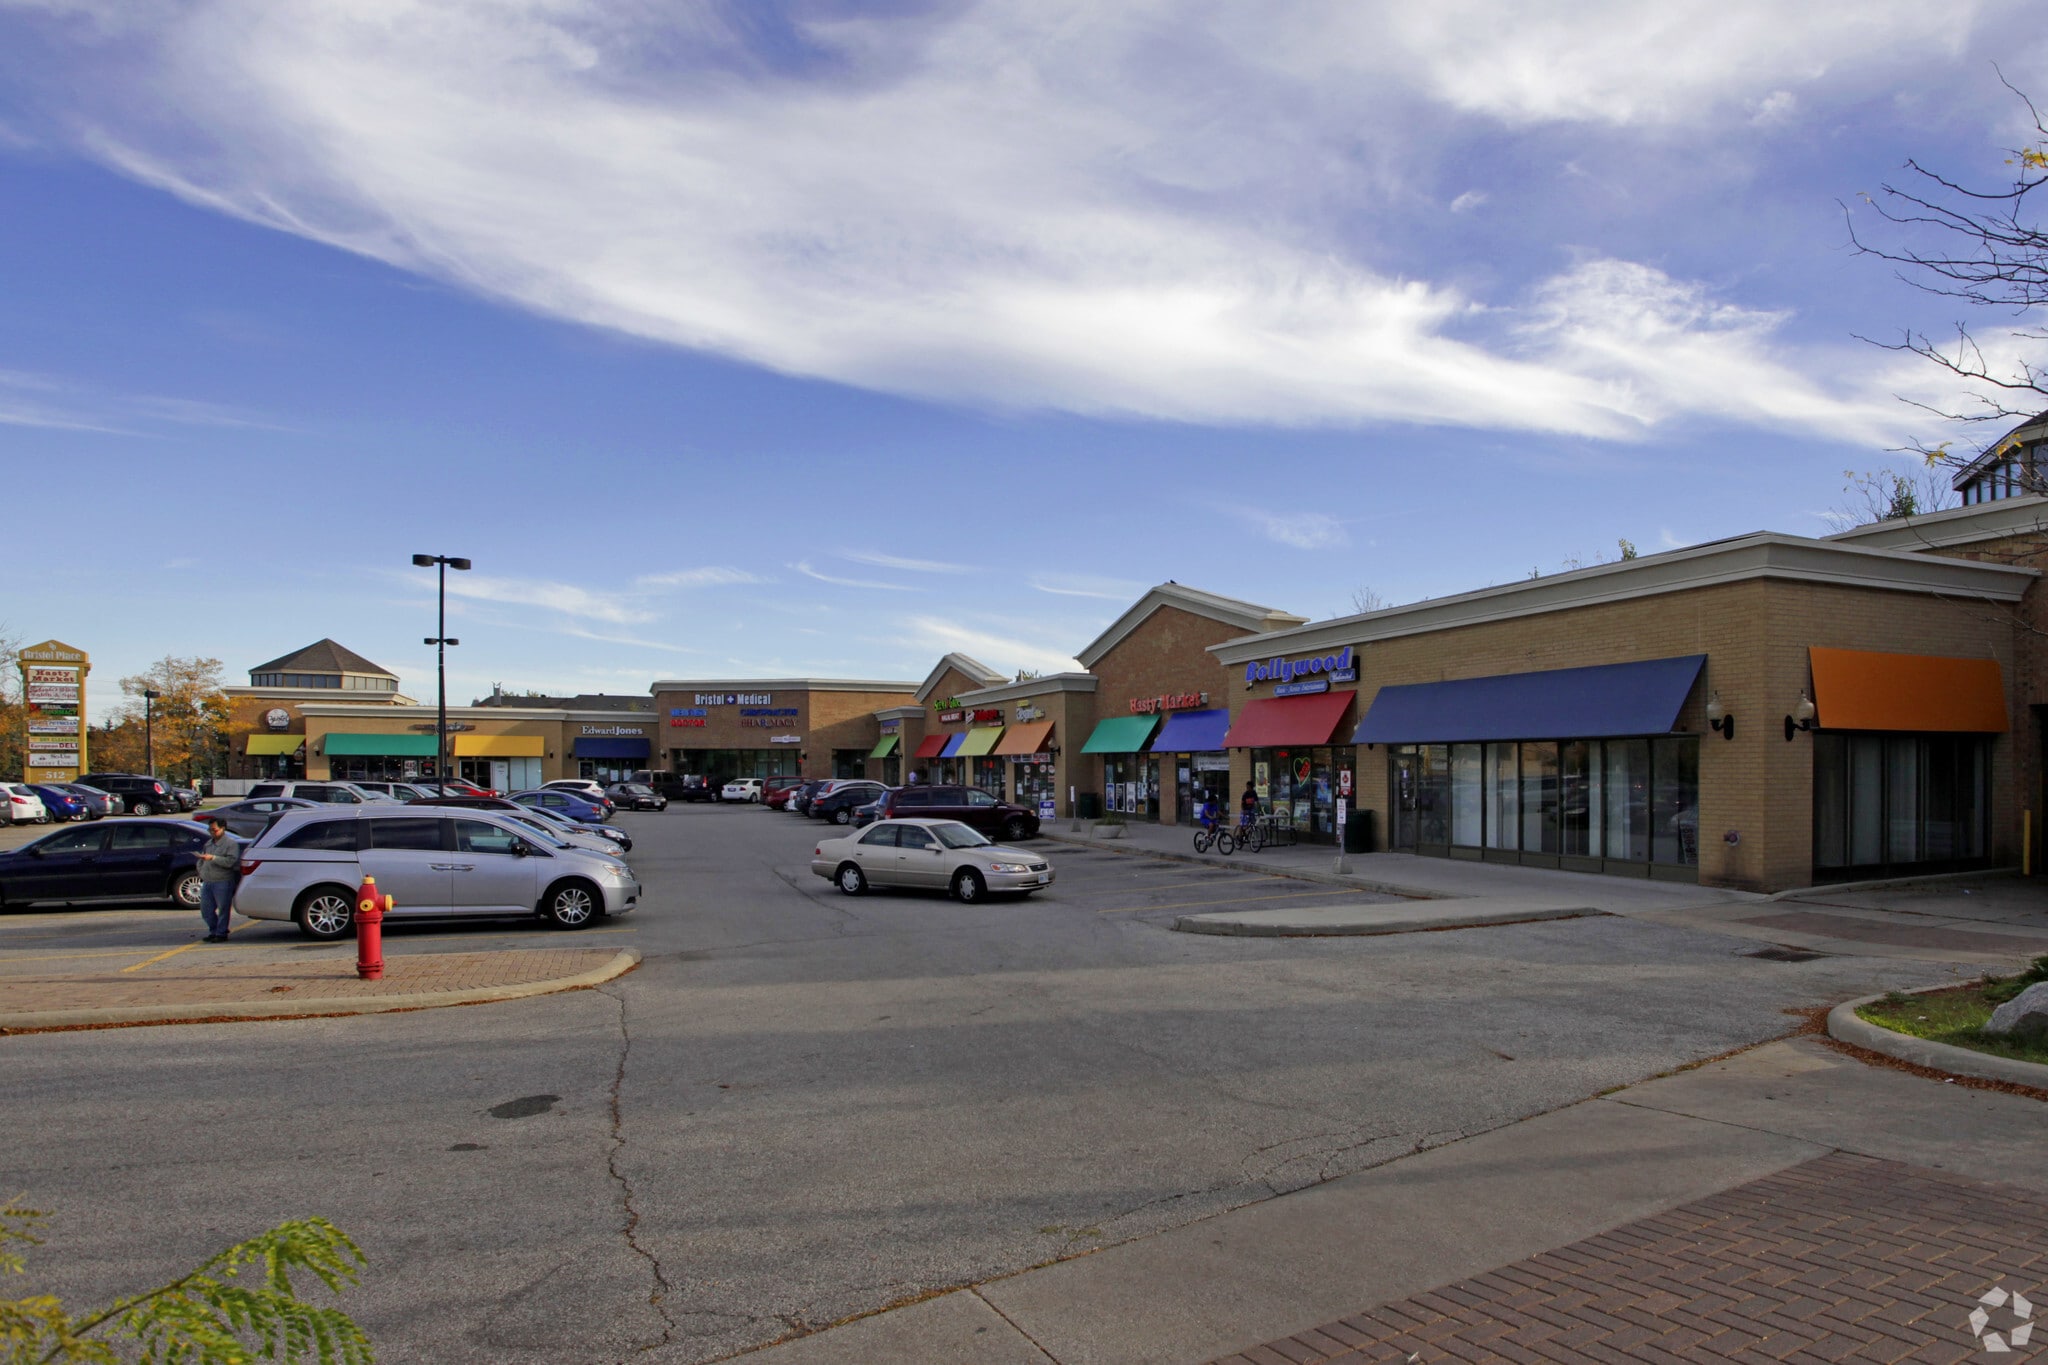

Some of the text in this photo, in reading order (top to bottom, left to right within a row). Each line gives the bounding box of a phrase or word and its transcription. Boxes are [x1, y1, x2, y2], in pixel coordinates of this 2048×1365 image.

[24, 651, 80, 660] Bristol Place
[1246, 647, 1352, 682] Bollywood
[695, 694, 771, 705] Bristol Medical
[1130, 692, 1201, 714] Hasty Market
[670, 719, 706, 727] DOCTOR
[741, 719, 797, 728] PHARMACY
[46, 771, 65, 779] 512
